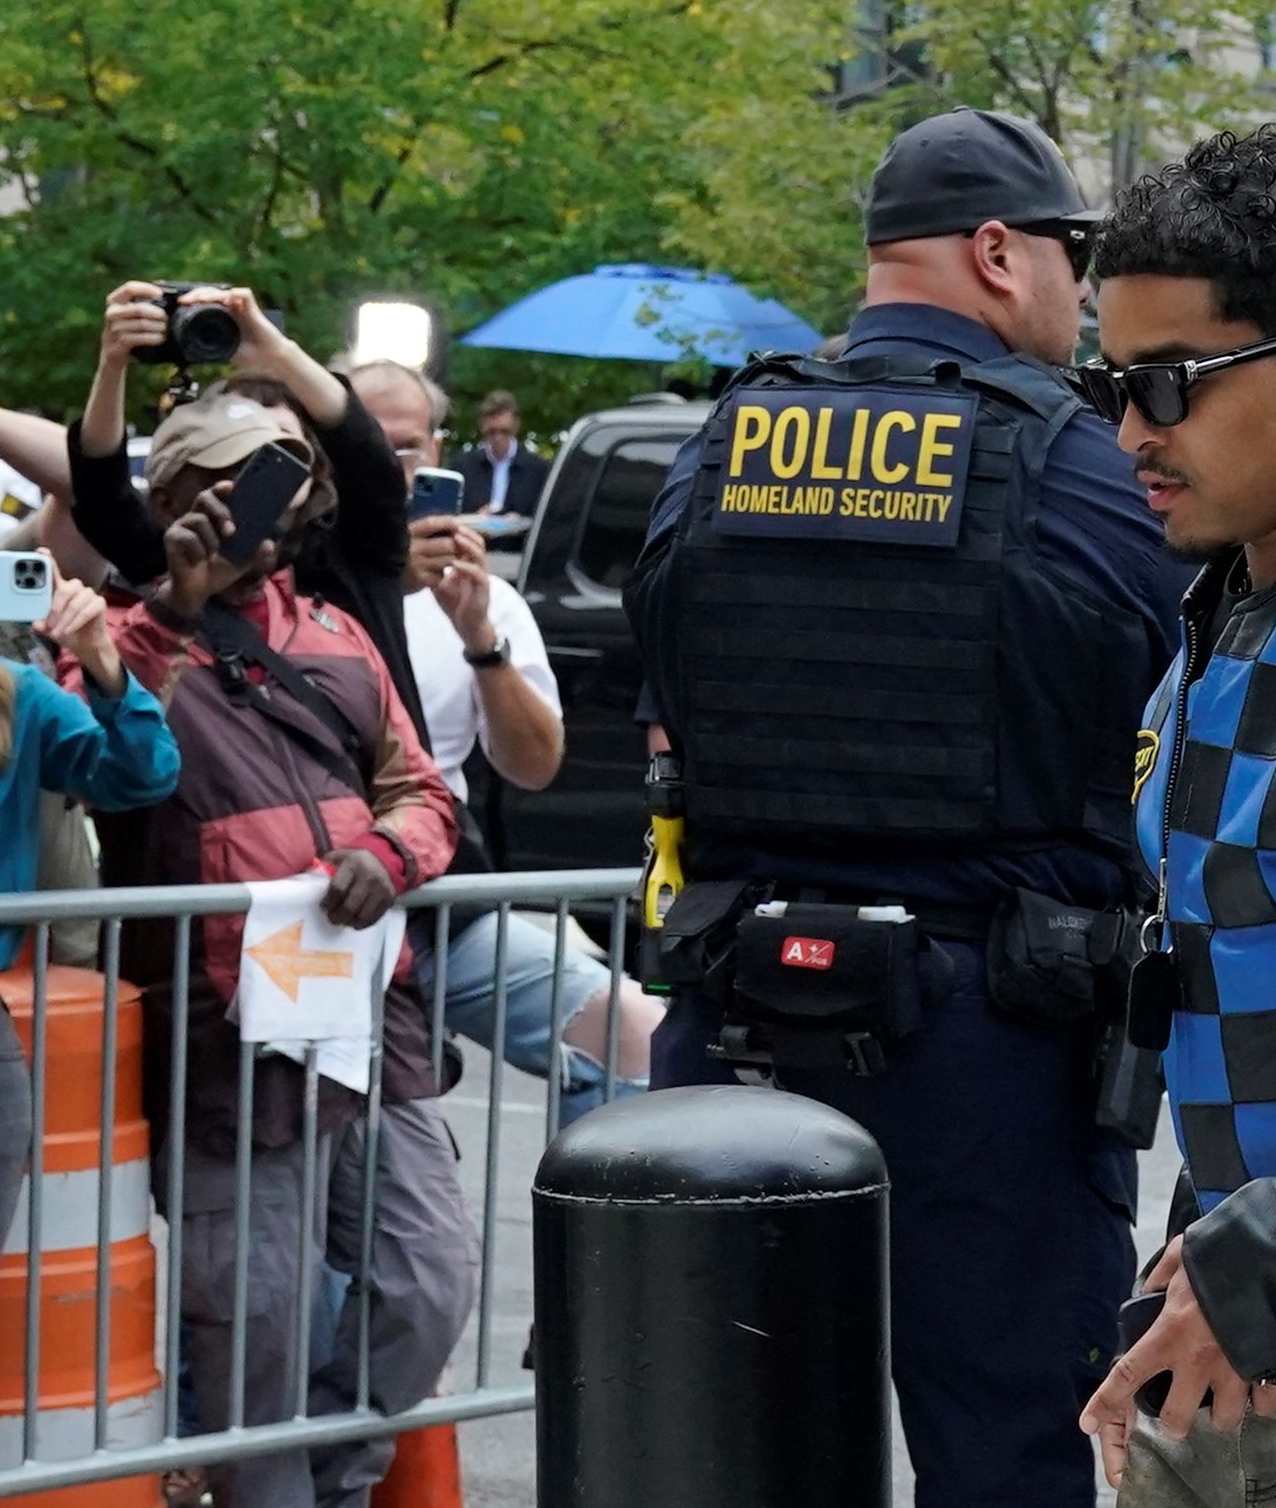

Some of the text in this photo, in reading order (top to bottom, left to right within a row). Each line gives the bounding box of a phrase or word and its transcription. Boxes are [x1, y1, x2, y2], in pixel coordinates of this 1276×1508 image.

[729, 405, 962, 488] POLICE
[720, 484, 954, 523] HOMELAND SECURITY
